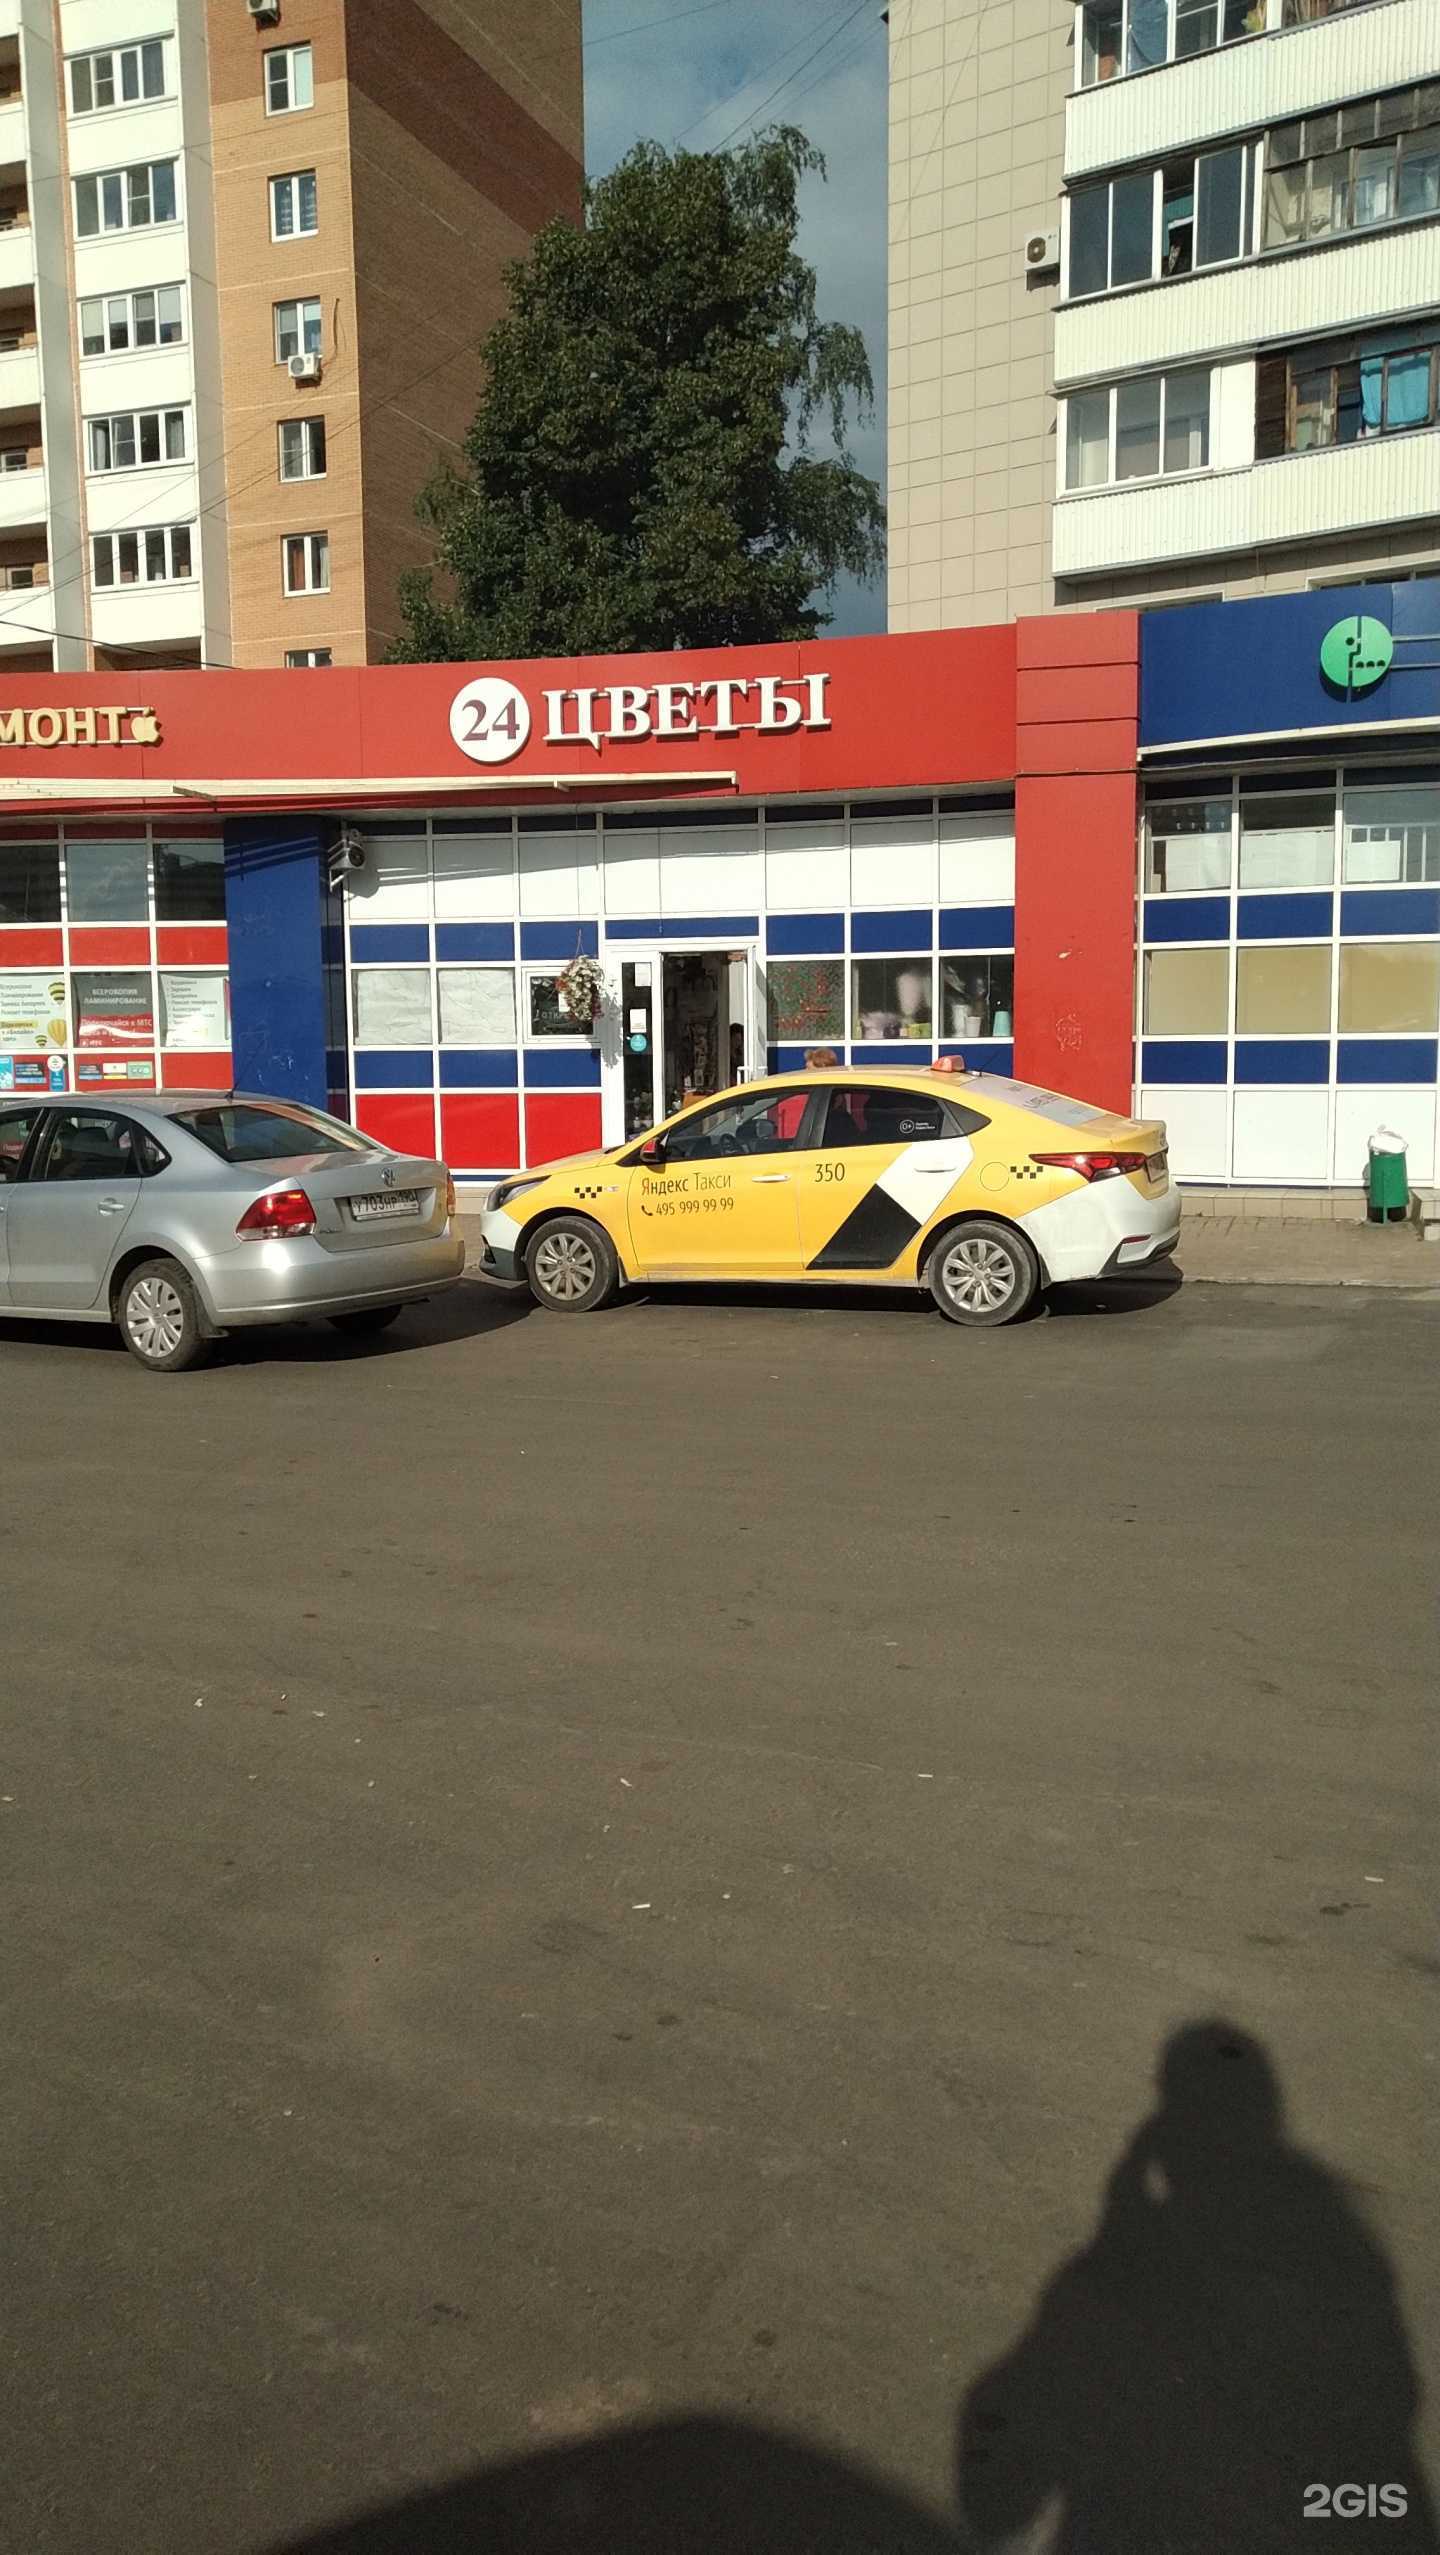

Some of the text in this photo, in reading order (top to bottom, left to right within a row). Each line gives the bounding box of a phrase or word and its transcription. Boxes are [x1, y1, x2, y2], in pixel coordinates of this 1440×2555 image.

[460, 673, 833, 751] 24 ЦВЕТЫ
[814, 1162, 846, 1183] 350
[641, 1172, 732, 1196] Яндекс Такси
[656, 1197, 734, 1216] 495 999 99 99
